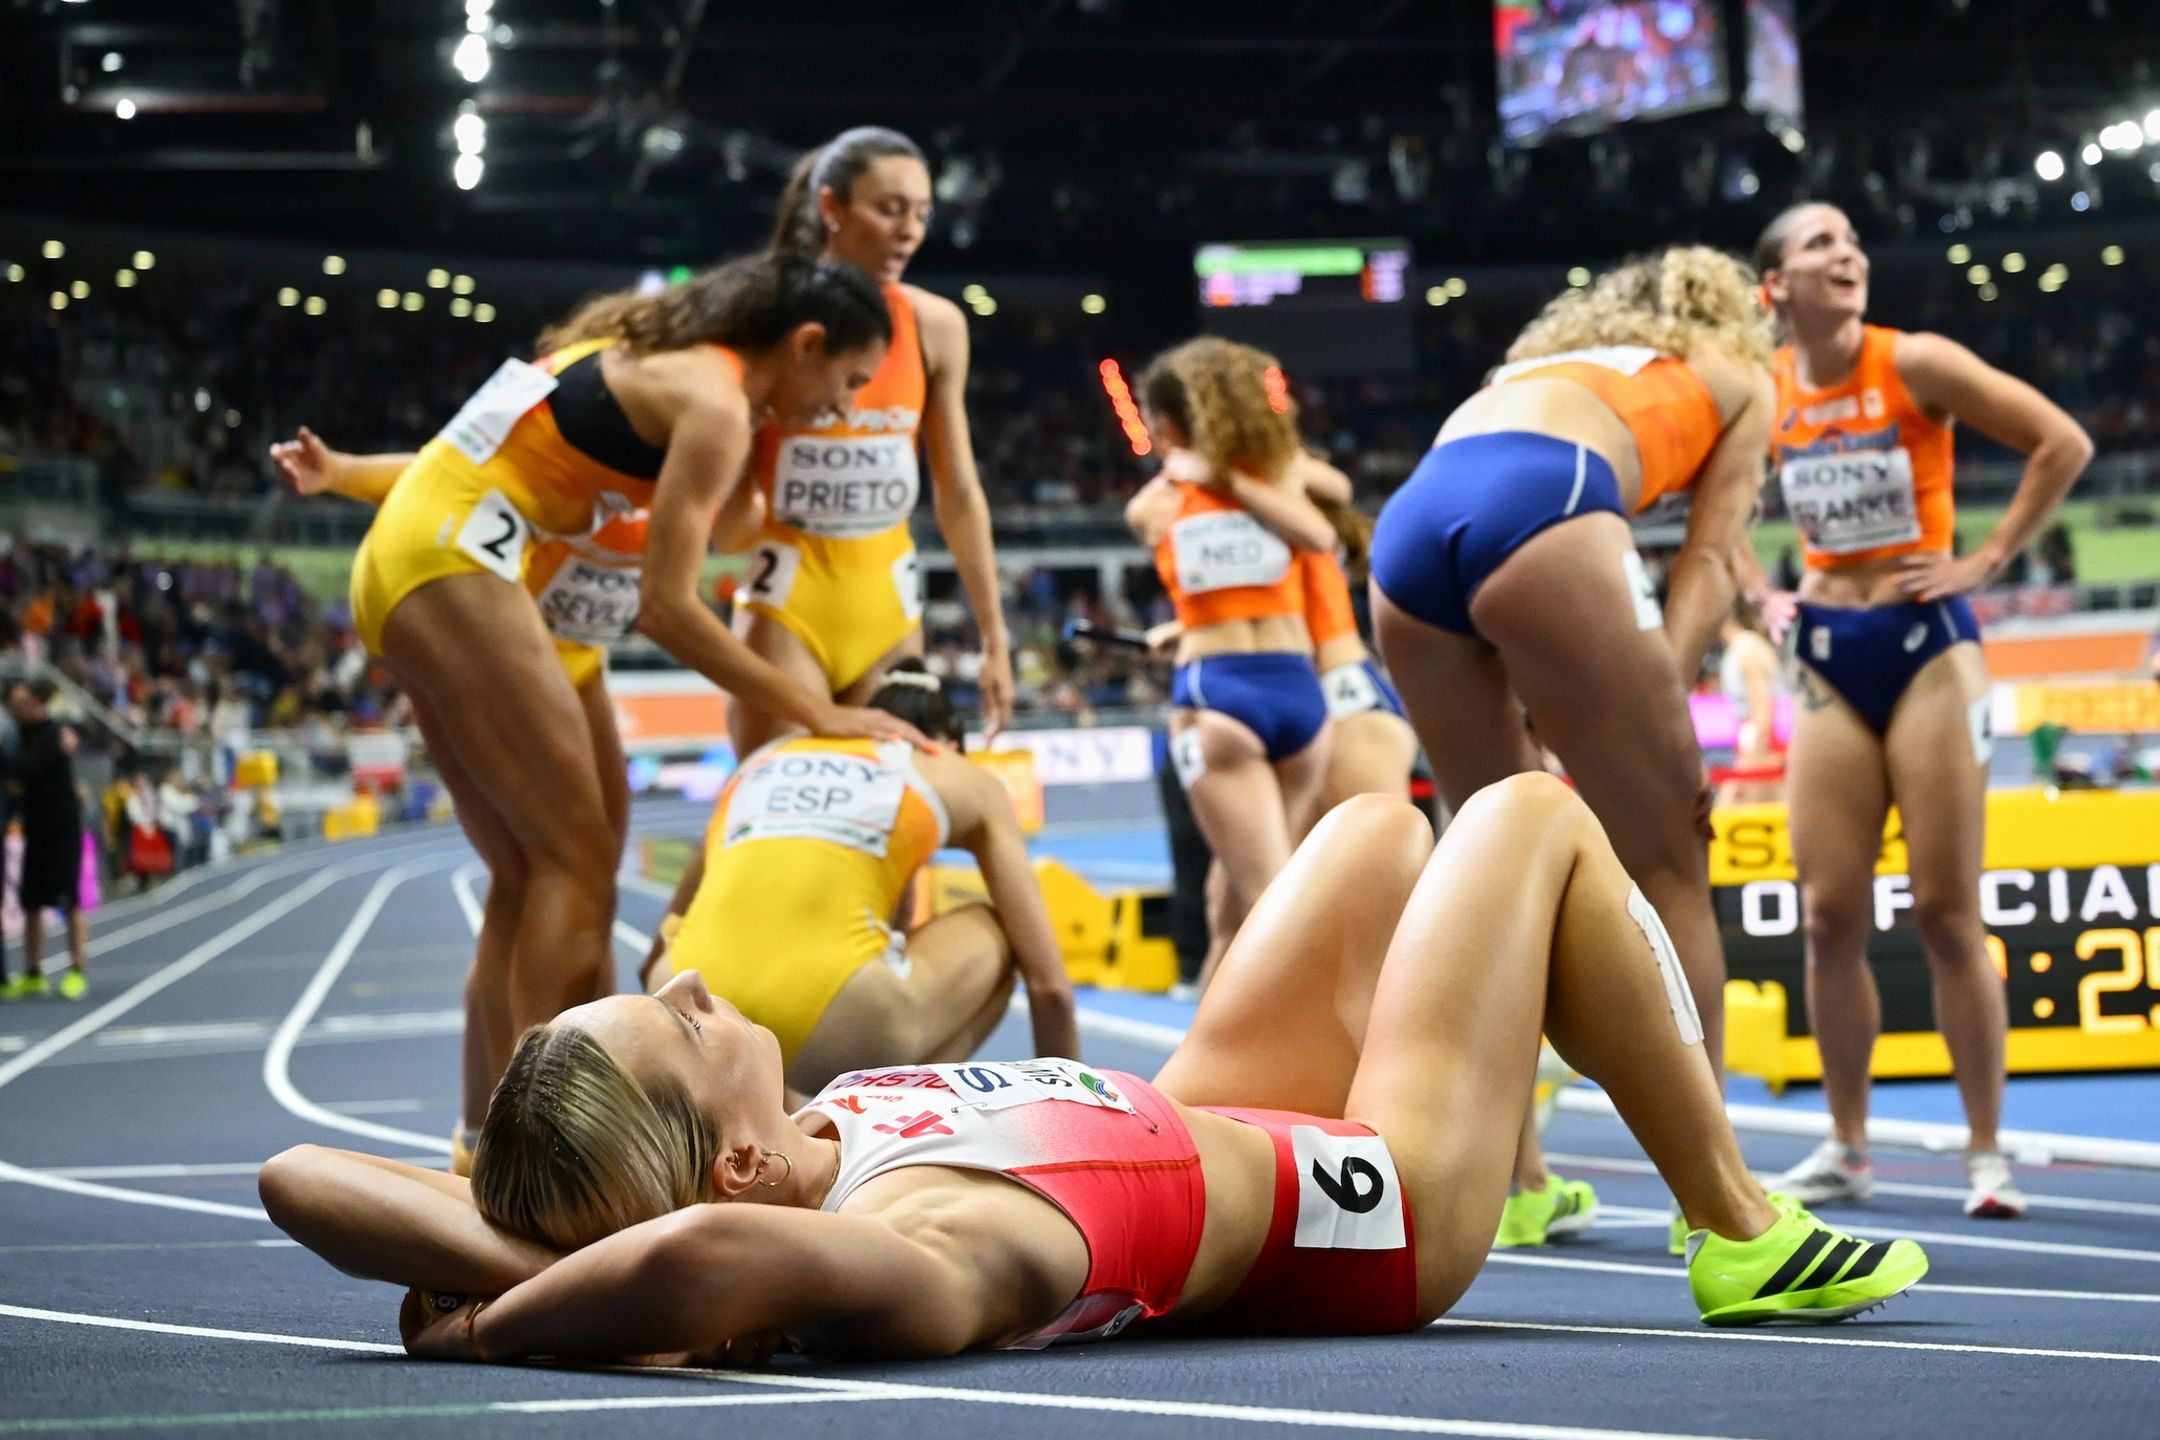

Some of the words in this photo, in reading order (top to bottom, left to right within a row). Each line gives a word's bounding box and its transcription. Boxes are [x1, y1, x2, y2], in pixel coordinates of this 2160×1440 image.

[792, 444, 902, 470] SONY
[1796, 462, 1889, 485] SONY
[785, 478, 908, 513] PRIETO
[481, 510, 518, 560] 2
[753, 548, 778, 593] 2
[766, 785, 852, 812] ESP
[1312, 1155, 1385, 1214] 6
